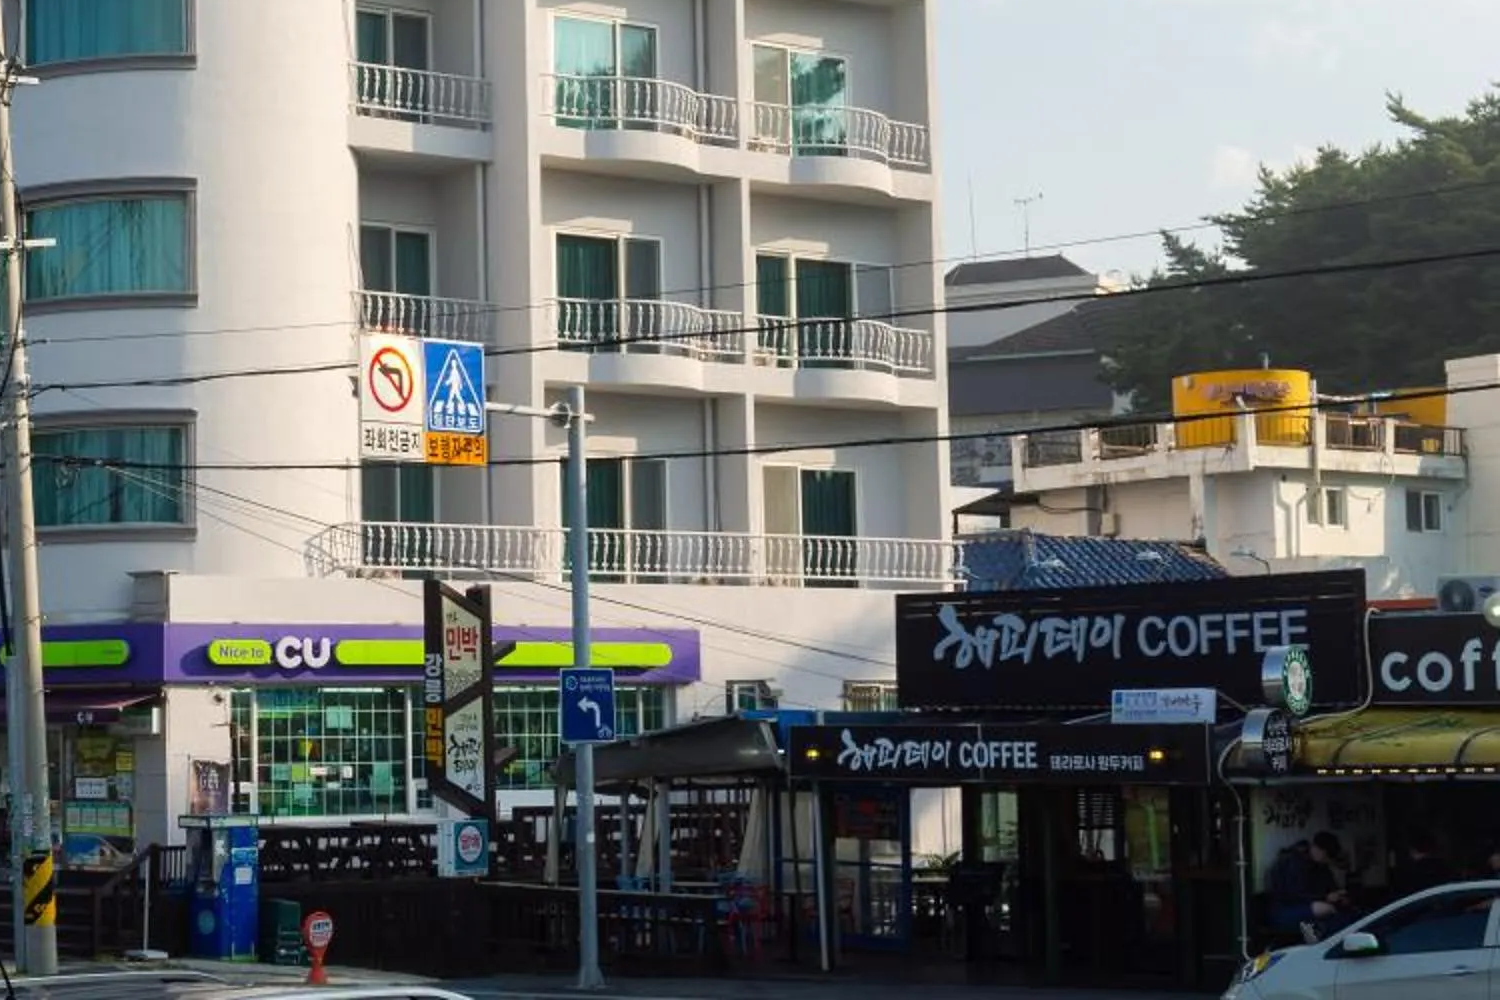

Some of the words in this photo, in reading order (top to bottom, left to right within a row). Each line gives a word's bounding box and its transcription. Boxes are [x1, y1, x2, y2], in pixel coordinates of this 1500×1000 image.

[363, 427, 421, 454] 좌회전금지
[428, 435, 485, 462] 보행자주의
[445, 626, 479, 661] 민박
[1136, 609, 1310, 658] COFFEE
[219, 645, 248, 658] Nice
[251, 646, 265, 658] to
[275, 635, 331, 669] CU
[76, 711, 94, 724] CU
[958, 741, 1039, 770] COFFEE
[1097, 754, 1145, 772] 원두커피
